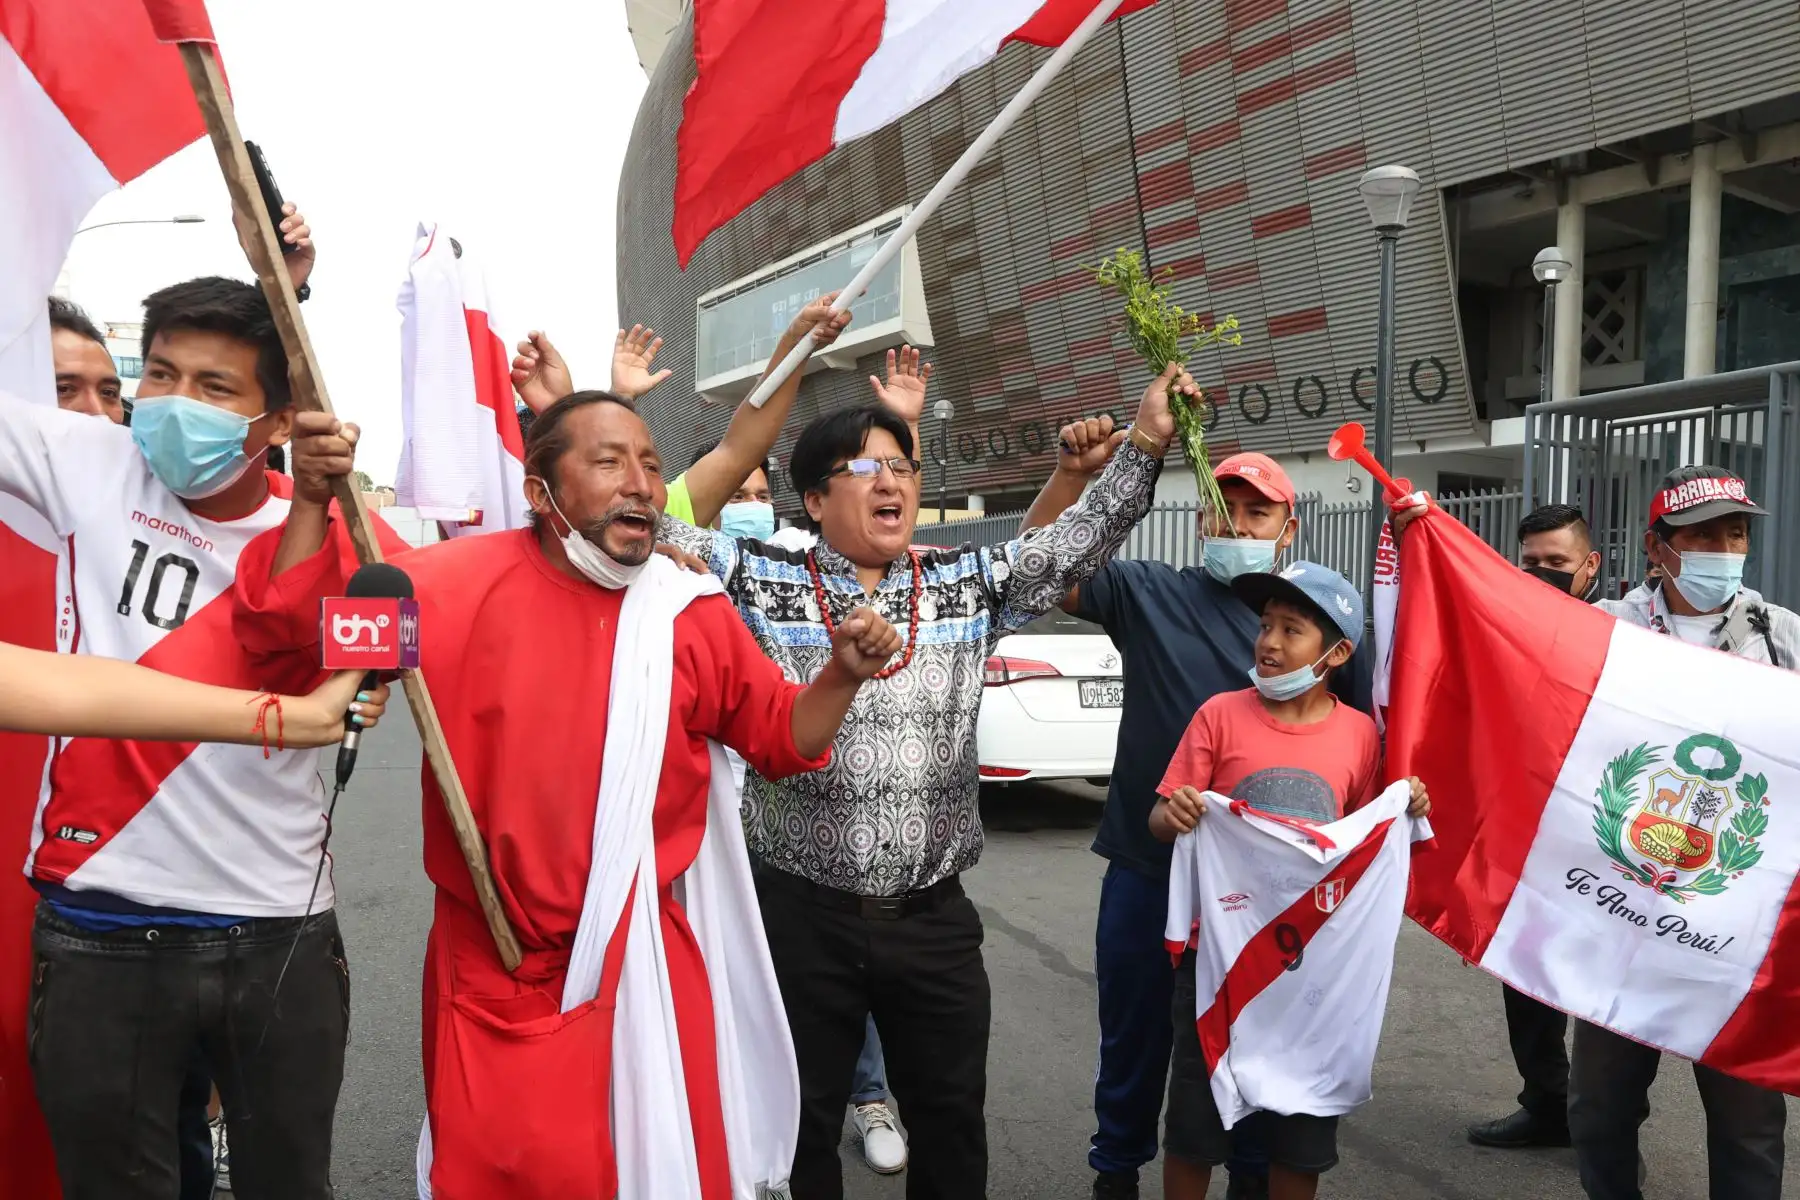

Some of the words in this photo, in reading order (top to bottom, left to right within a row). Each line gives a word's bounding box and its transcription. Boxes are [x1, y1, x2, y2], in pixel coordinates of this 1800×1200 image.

[1663, 478, 1726, 509] ¡ARRIBA
[131, 510, 214, 552] marathon
[116, 539, 200, 631] 10
[370, 645, 390, 653] canal
[1565, 867, 1600, 895] Te
[1596, 885, 1648, 927] Amo
[1655, 914, 1735, 955] Perú!
[1275, 922, 1304, 972] 9
